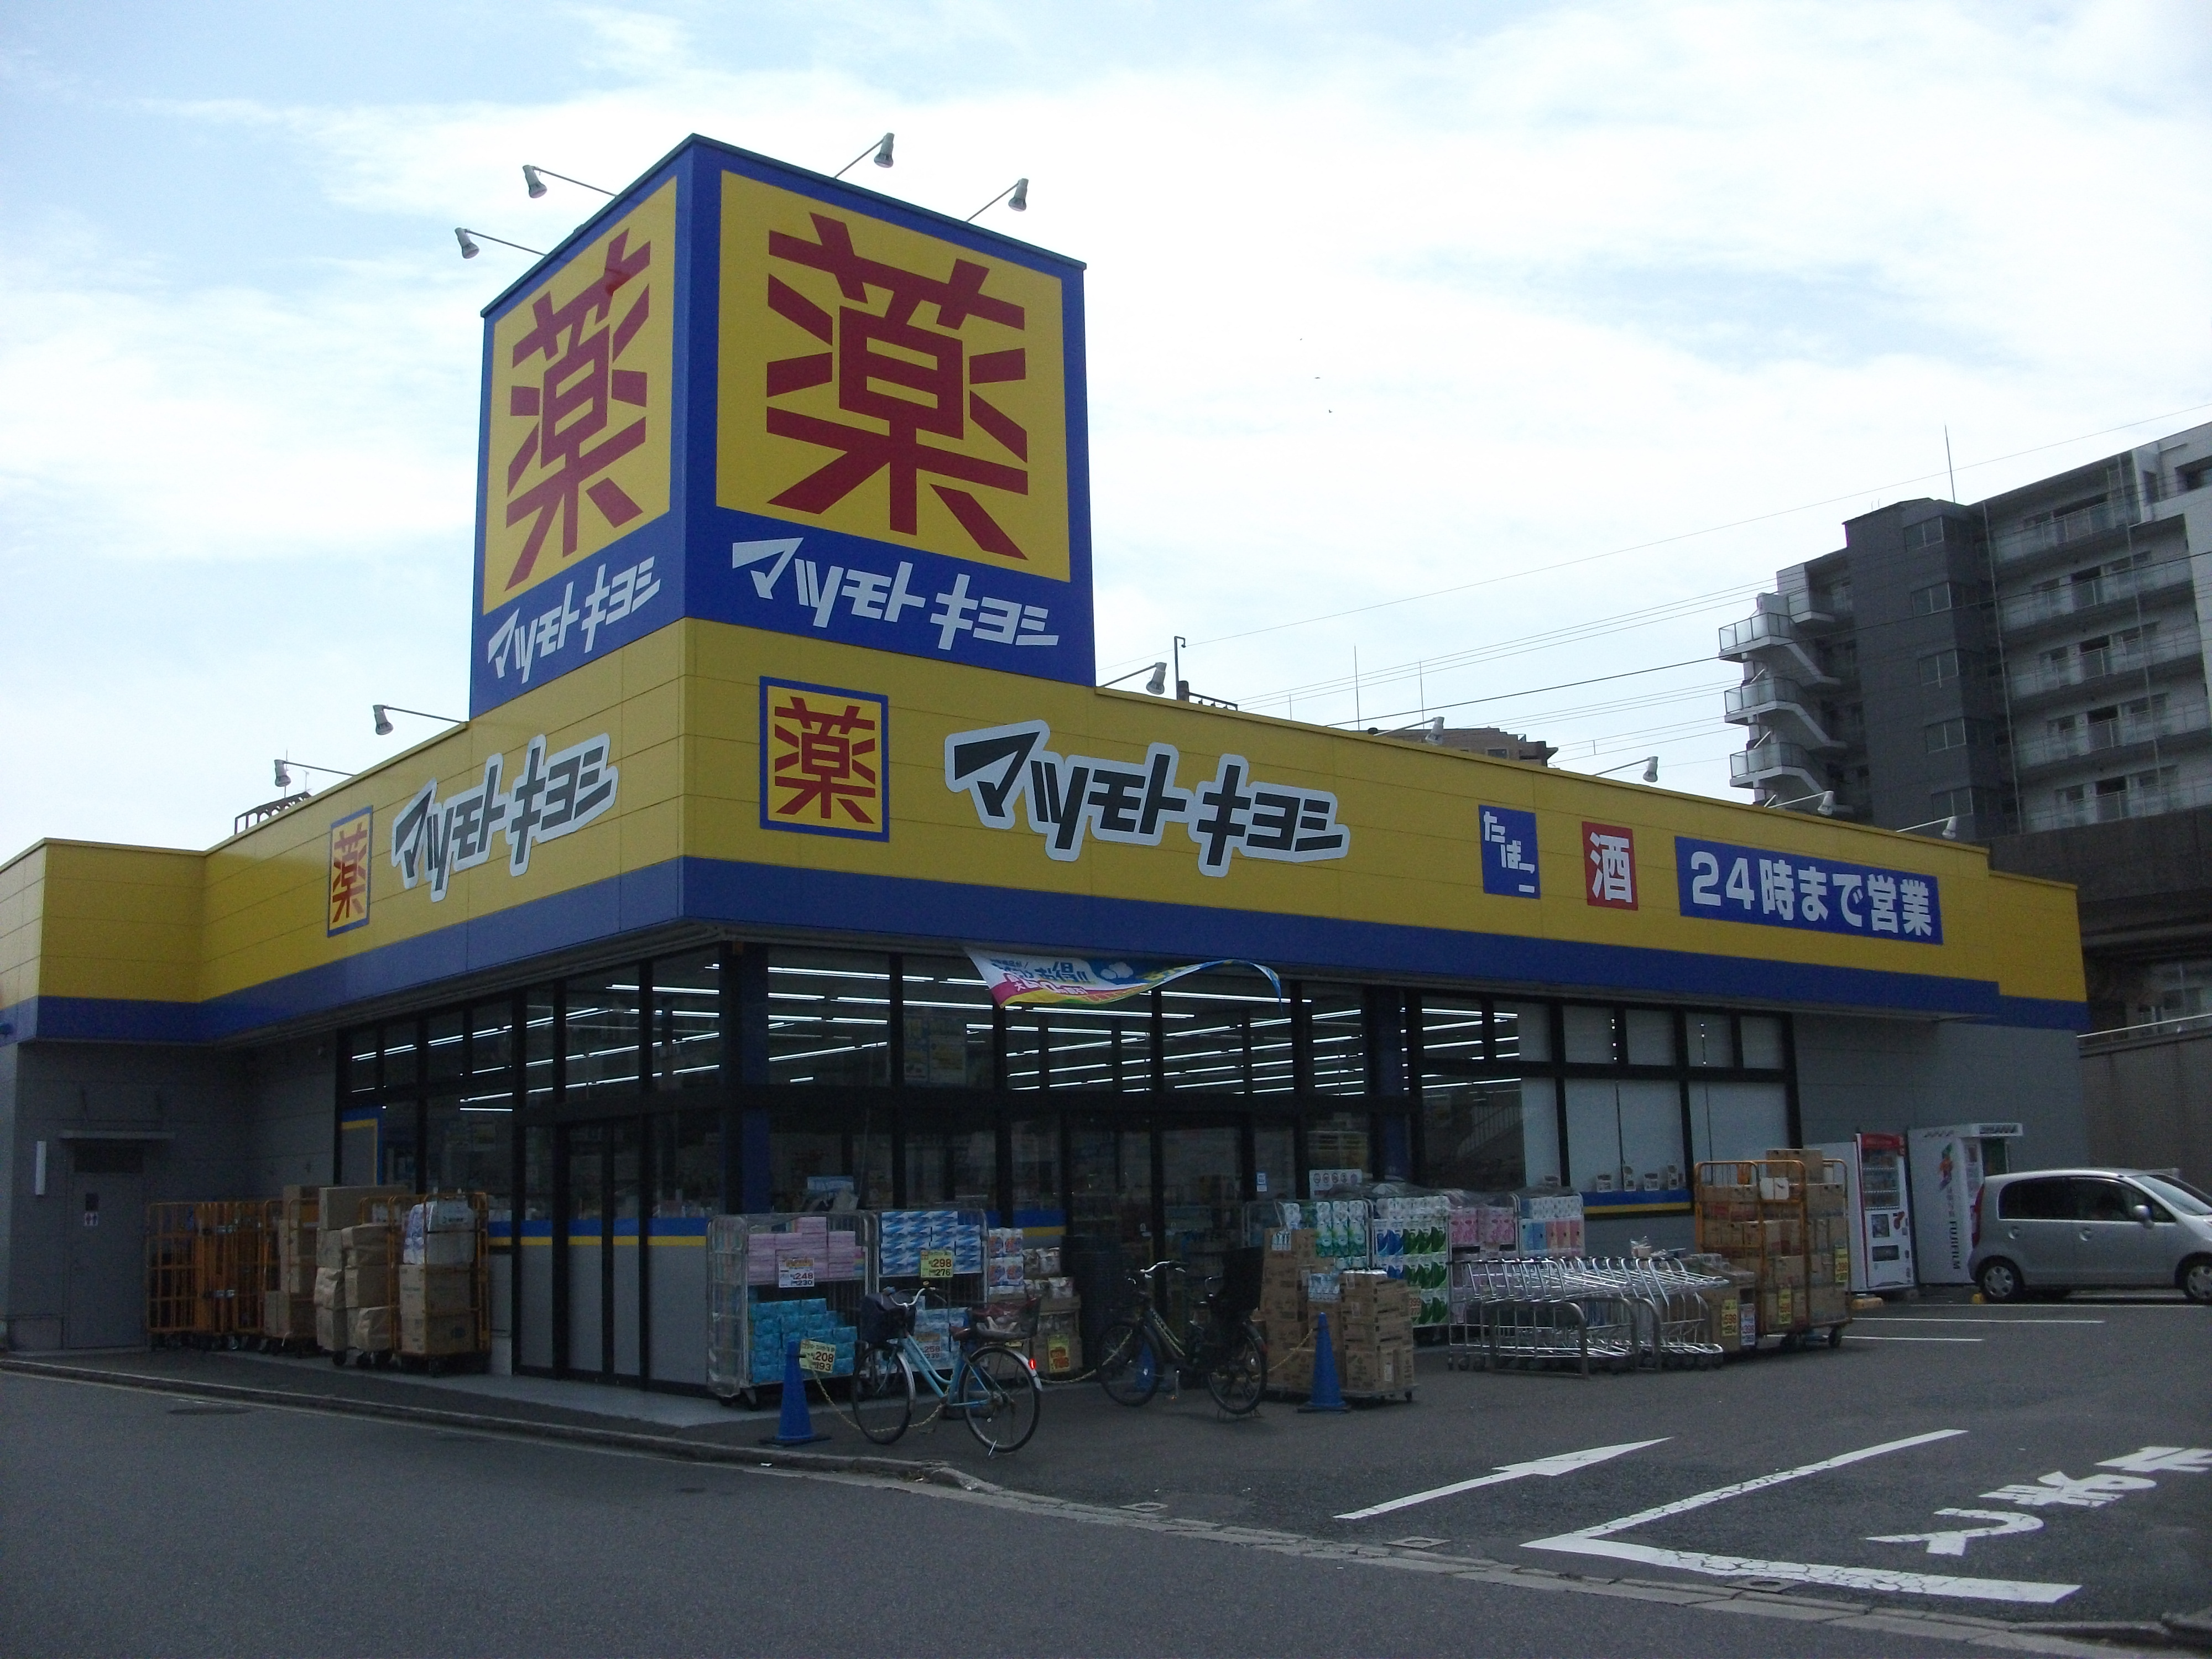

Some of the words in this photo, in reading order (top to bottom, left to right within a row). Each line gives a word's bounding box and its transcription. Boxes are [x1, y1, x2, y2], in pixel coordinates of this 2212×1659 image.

[504, 228, 651, 591] 薬
[766, 212, 1029, 560] 薬
[488, 555, 661, 683] マツモトキヨシ
[732, 536, 1058, 650] マツモトキヨシ
[395, 745, 613, 893] マツモトキヨシ
[774, 697, 875, 824] 薬
[952, 730, 1344, 867] マツモトキヨシ
[332, 822, 367, 923] 薬
[1589, 831, 1632, 903] 酒
[1691, 850, 1933, 937] 24時まで営業
[933, 1259, 952, 1267] 298
[815, 1351, 834, 1363] 208
